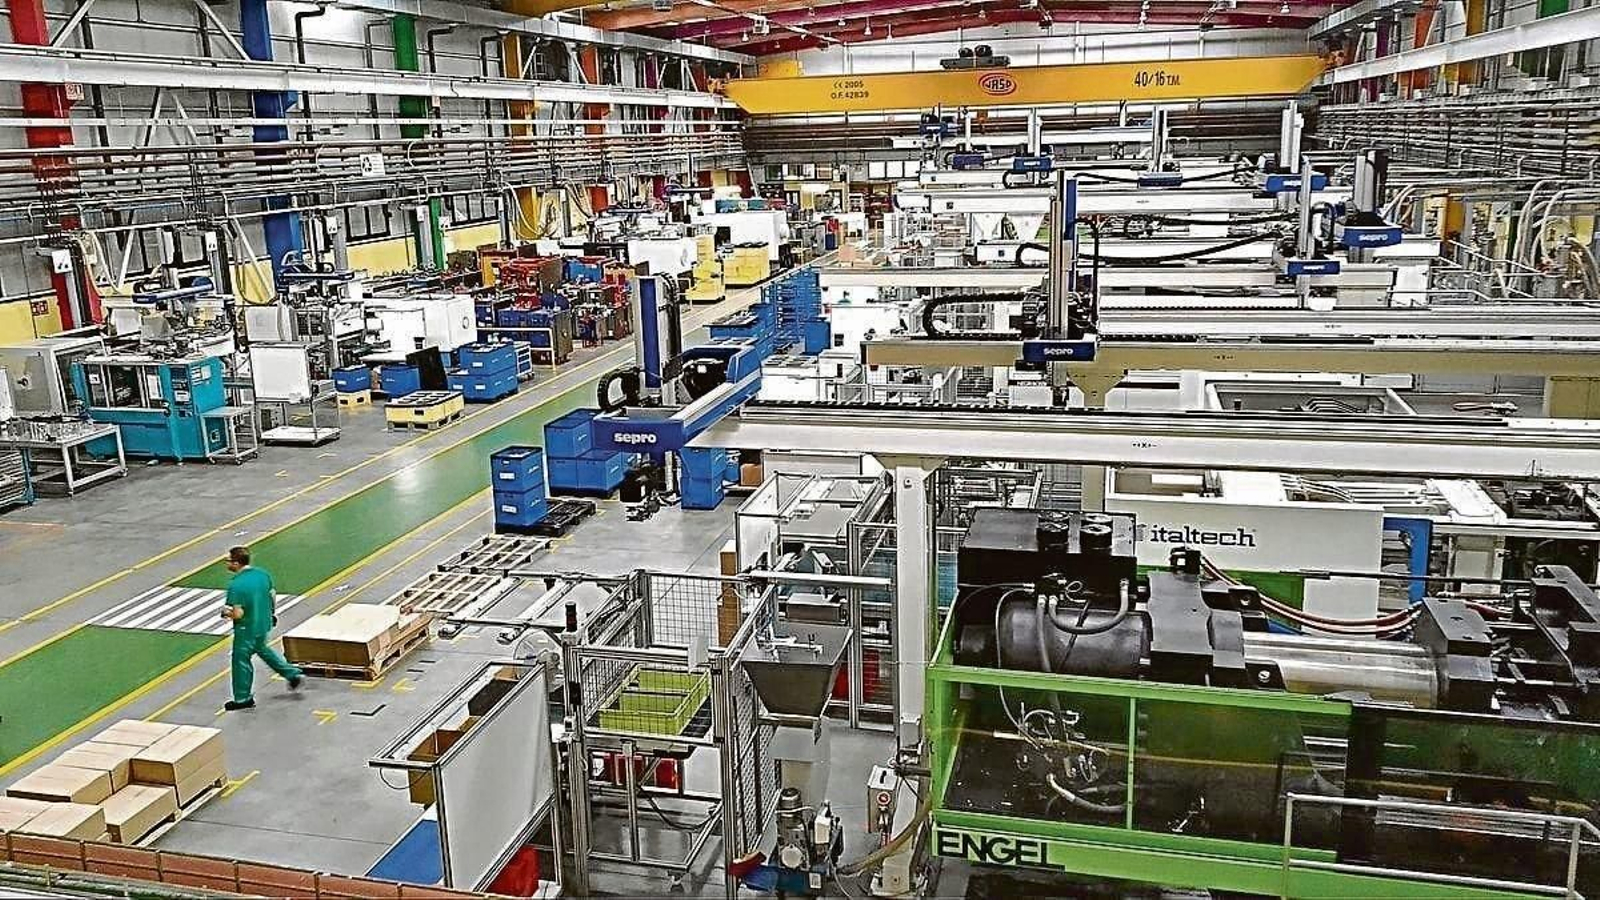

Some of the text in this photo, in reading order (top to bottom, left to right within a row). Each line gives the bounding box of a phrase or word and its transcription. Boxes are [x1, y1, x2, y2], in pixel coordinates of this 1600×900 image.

[1134, 70, 1165, 87] 40/16
[1043, 347, 1074, 356] sepro
[613, 432, 657, 445] sepro
[1150, 524, 1256, 547] italtech
[938, 830, 1065, 871] ENGEL
